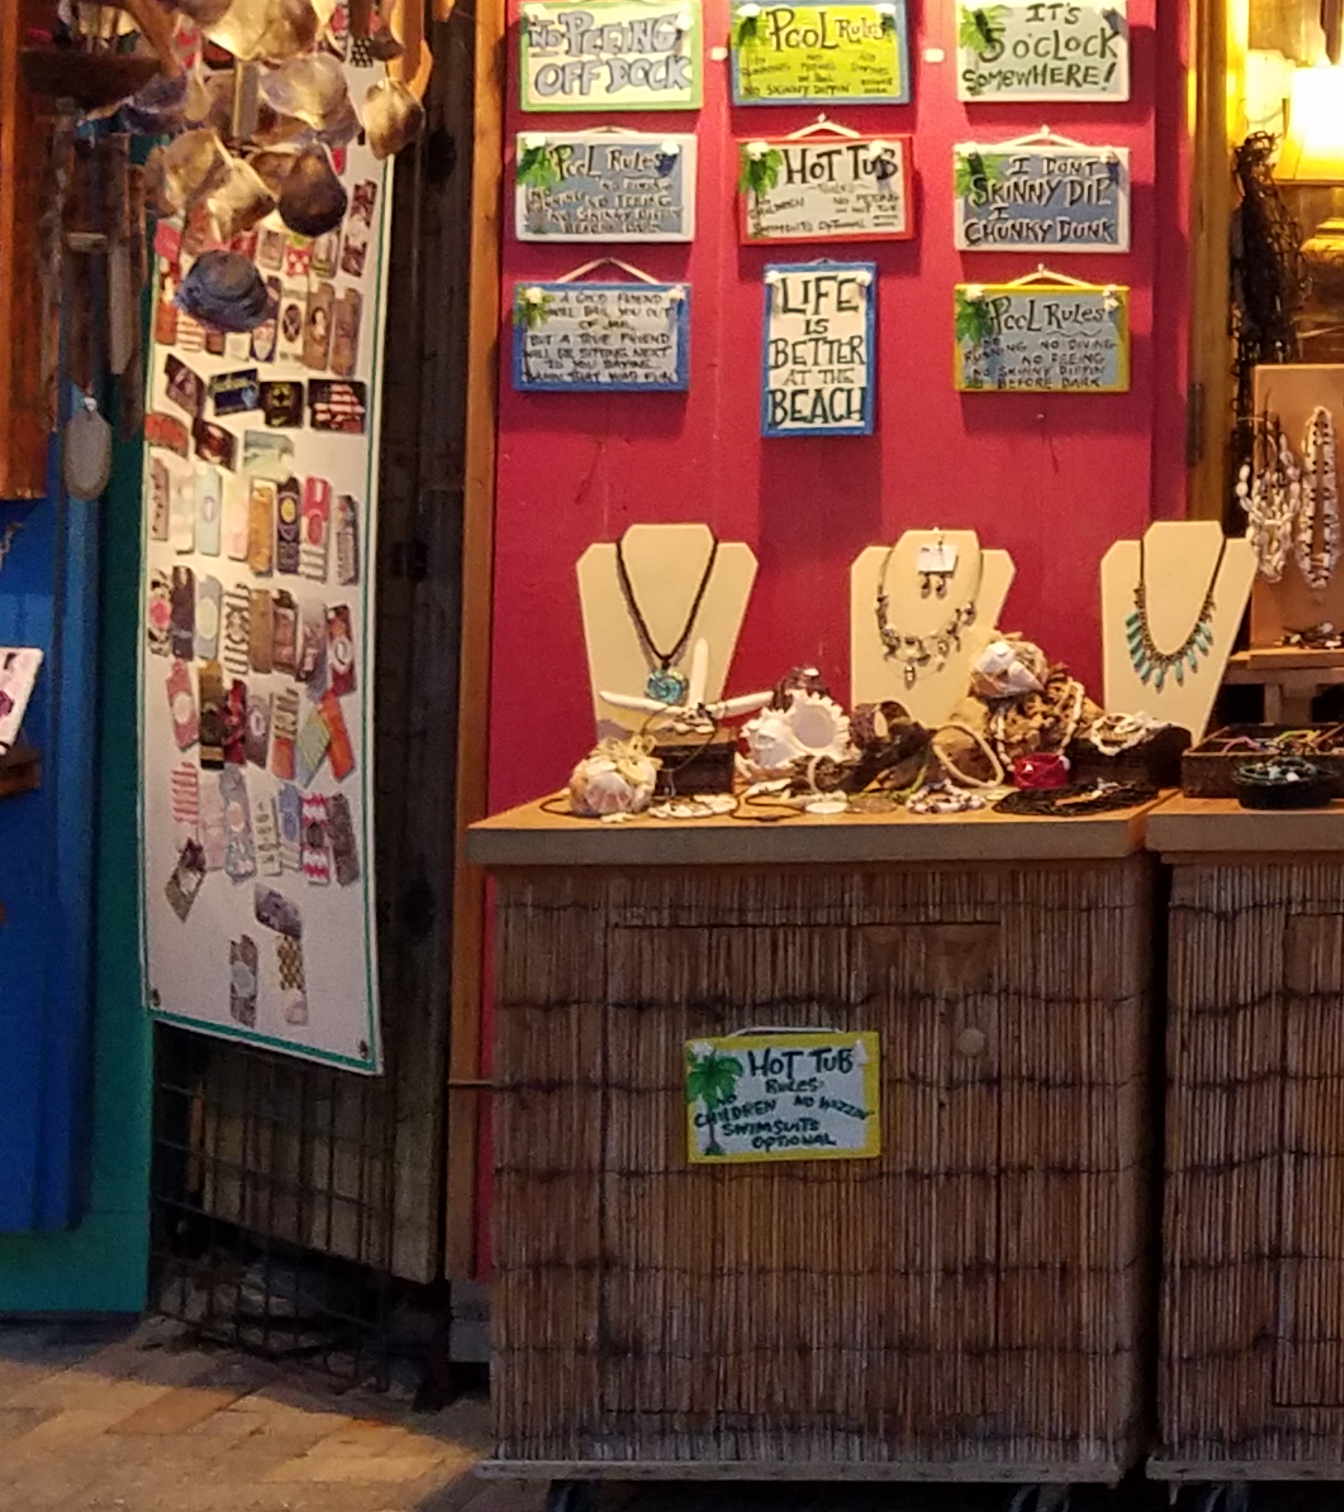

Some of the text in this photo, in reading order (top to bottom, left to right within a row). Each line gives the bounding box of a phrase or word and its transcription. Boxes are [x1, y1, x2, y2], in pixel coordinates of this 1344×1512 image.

[529, 10, 680, 58] NO PEEING
[535, 54, 694, 97] OFF DOCK
[782, 143, 899, 185] HOT TUB
[969, 174, 1063, 208] SKINNY
[964, 216, 1116, 246] CHUNKY DUNK
[781, 275, 860, 316] LIFE
[803, 318, 830, 336] IS
[768, 335, 866, 370] BETTER
[782, 367, 856, 386] AT THE
[767, 386, 867, 428] BEACH
[747, 1047, 854, 1079] HOT TUB
[693, 1098, 777, 1128] CHILDREN
[793, 1095, 814, 1108] NO
[720, 1117, 820, 1137] SWIMSUITS
[751, 1132, 837, 1153] OPTIONAL
